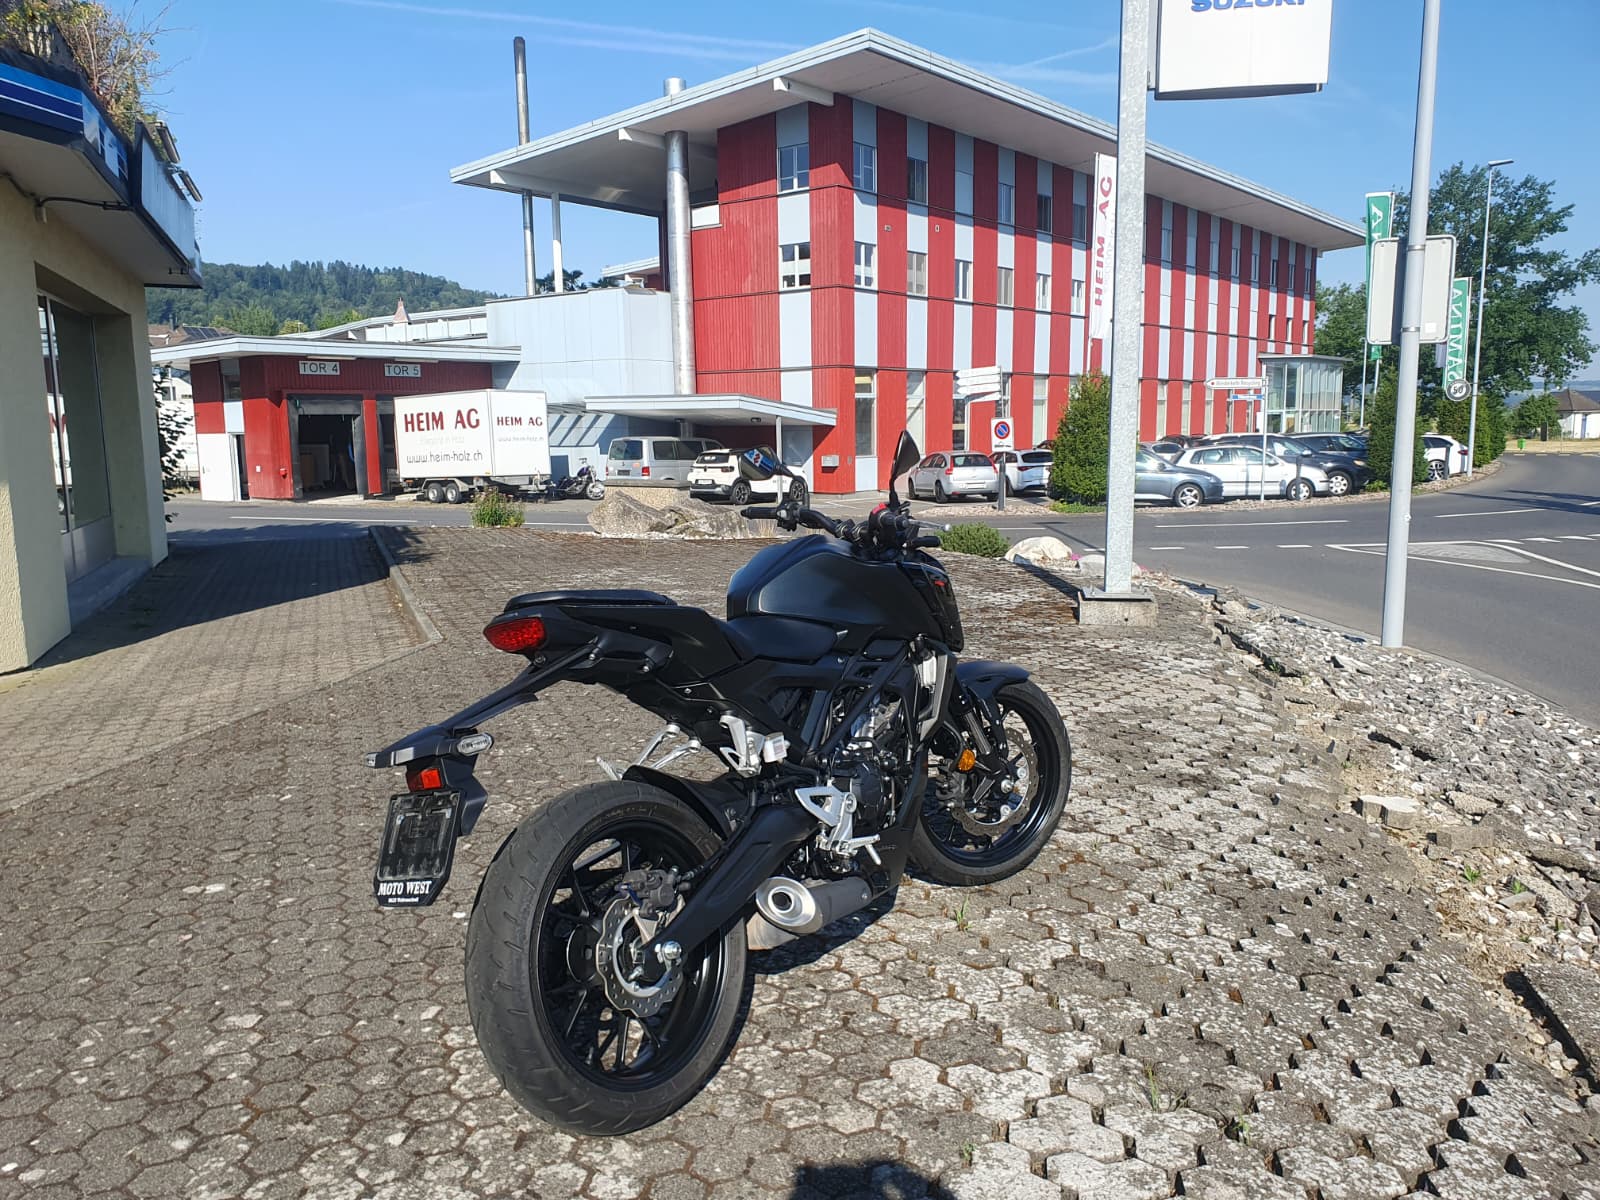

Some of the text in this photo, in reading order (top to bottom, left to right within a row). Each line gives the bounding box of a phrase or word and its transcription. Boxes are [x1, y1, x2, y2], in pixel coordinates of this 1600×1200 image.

[1098, 176, 1112, 220] AG
[1094, 236, 1105, 306] HEIM
[301, 362, 338, 373] TOR 4
[386, 365, 419, 375] TOR 5
[404, 408, 480, 432] HEIM AG
[497, 416, 543, 426] HEIM AG
[406, 450, 483, 464] www.heim-holz.ch
[378, 881, 432, 895] MOTO WEST
